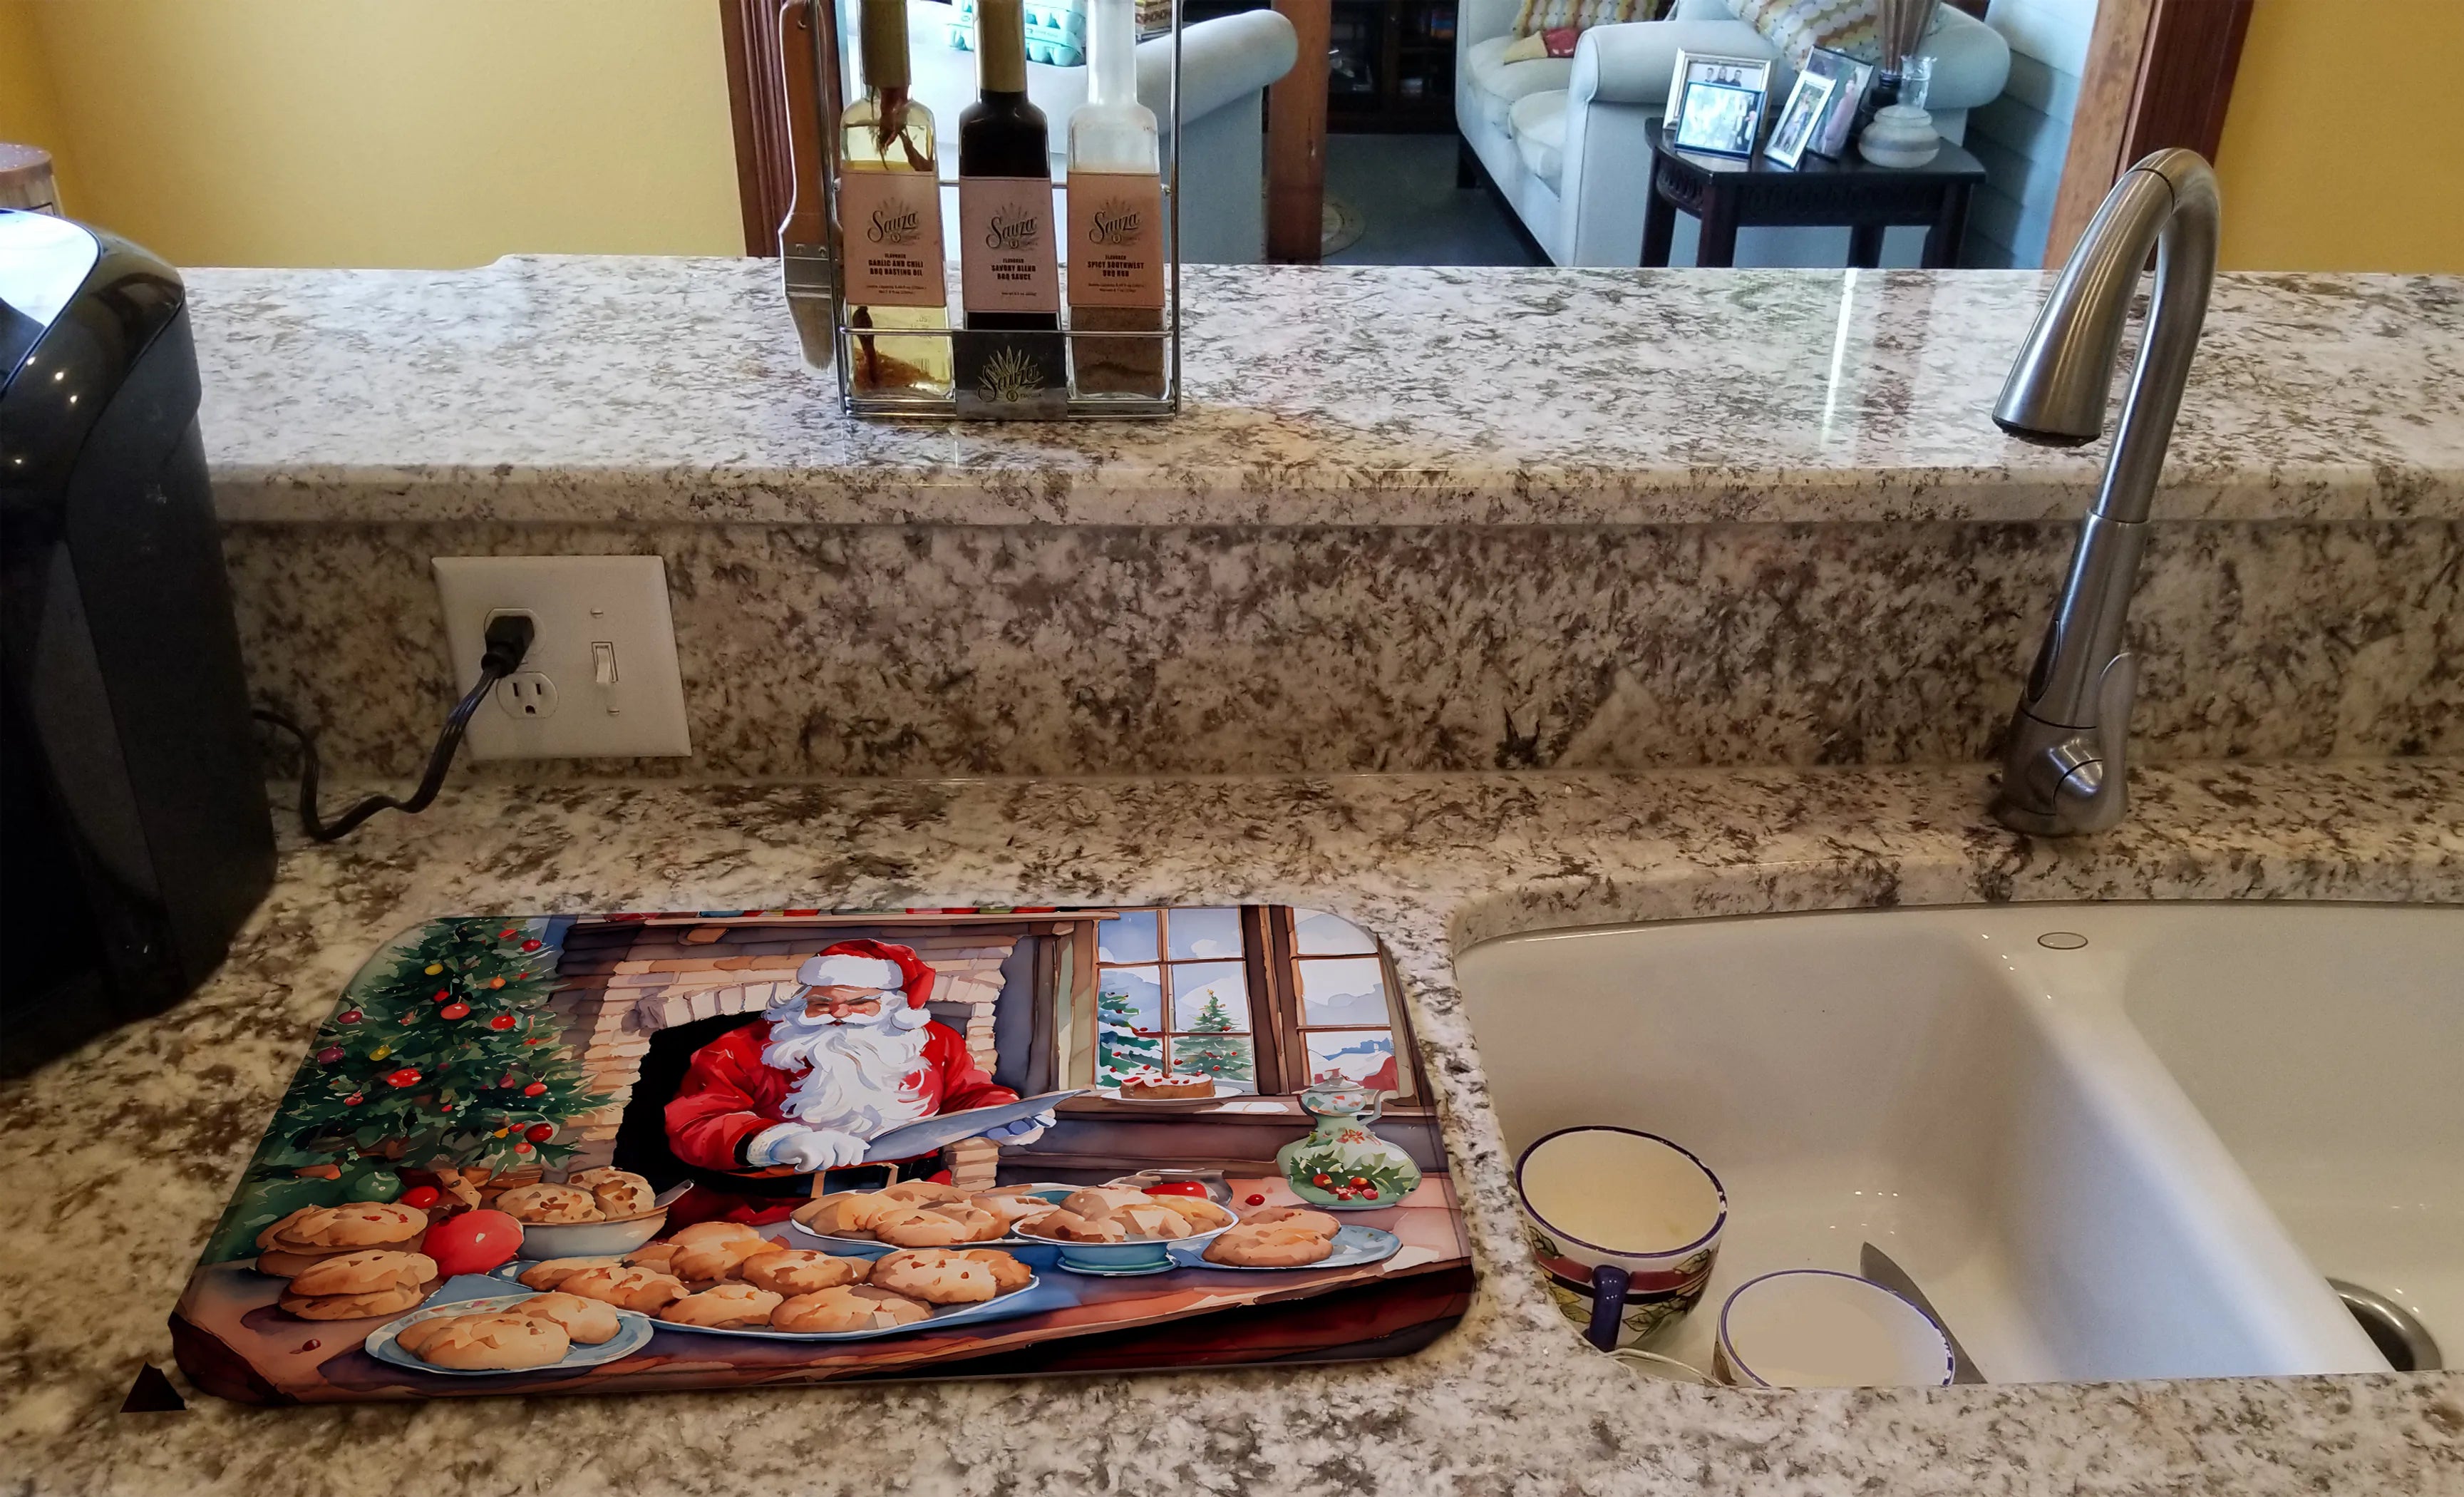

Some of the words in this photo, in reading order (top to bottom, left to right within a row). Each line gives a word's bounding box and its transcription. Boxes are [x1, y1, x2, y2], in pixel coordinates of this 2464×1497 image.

[867, 210, 918, 243] Sauza
[986, 216, 1037, 249] Sauza
[1089, 212, 1140, 245] Sauza
[977, 364, 1043, 403] Sauza
